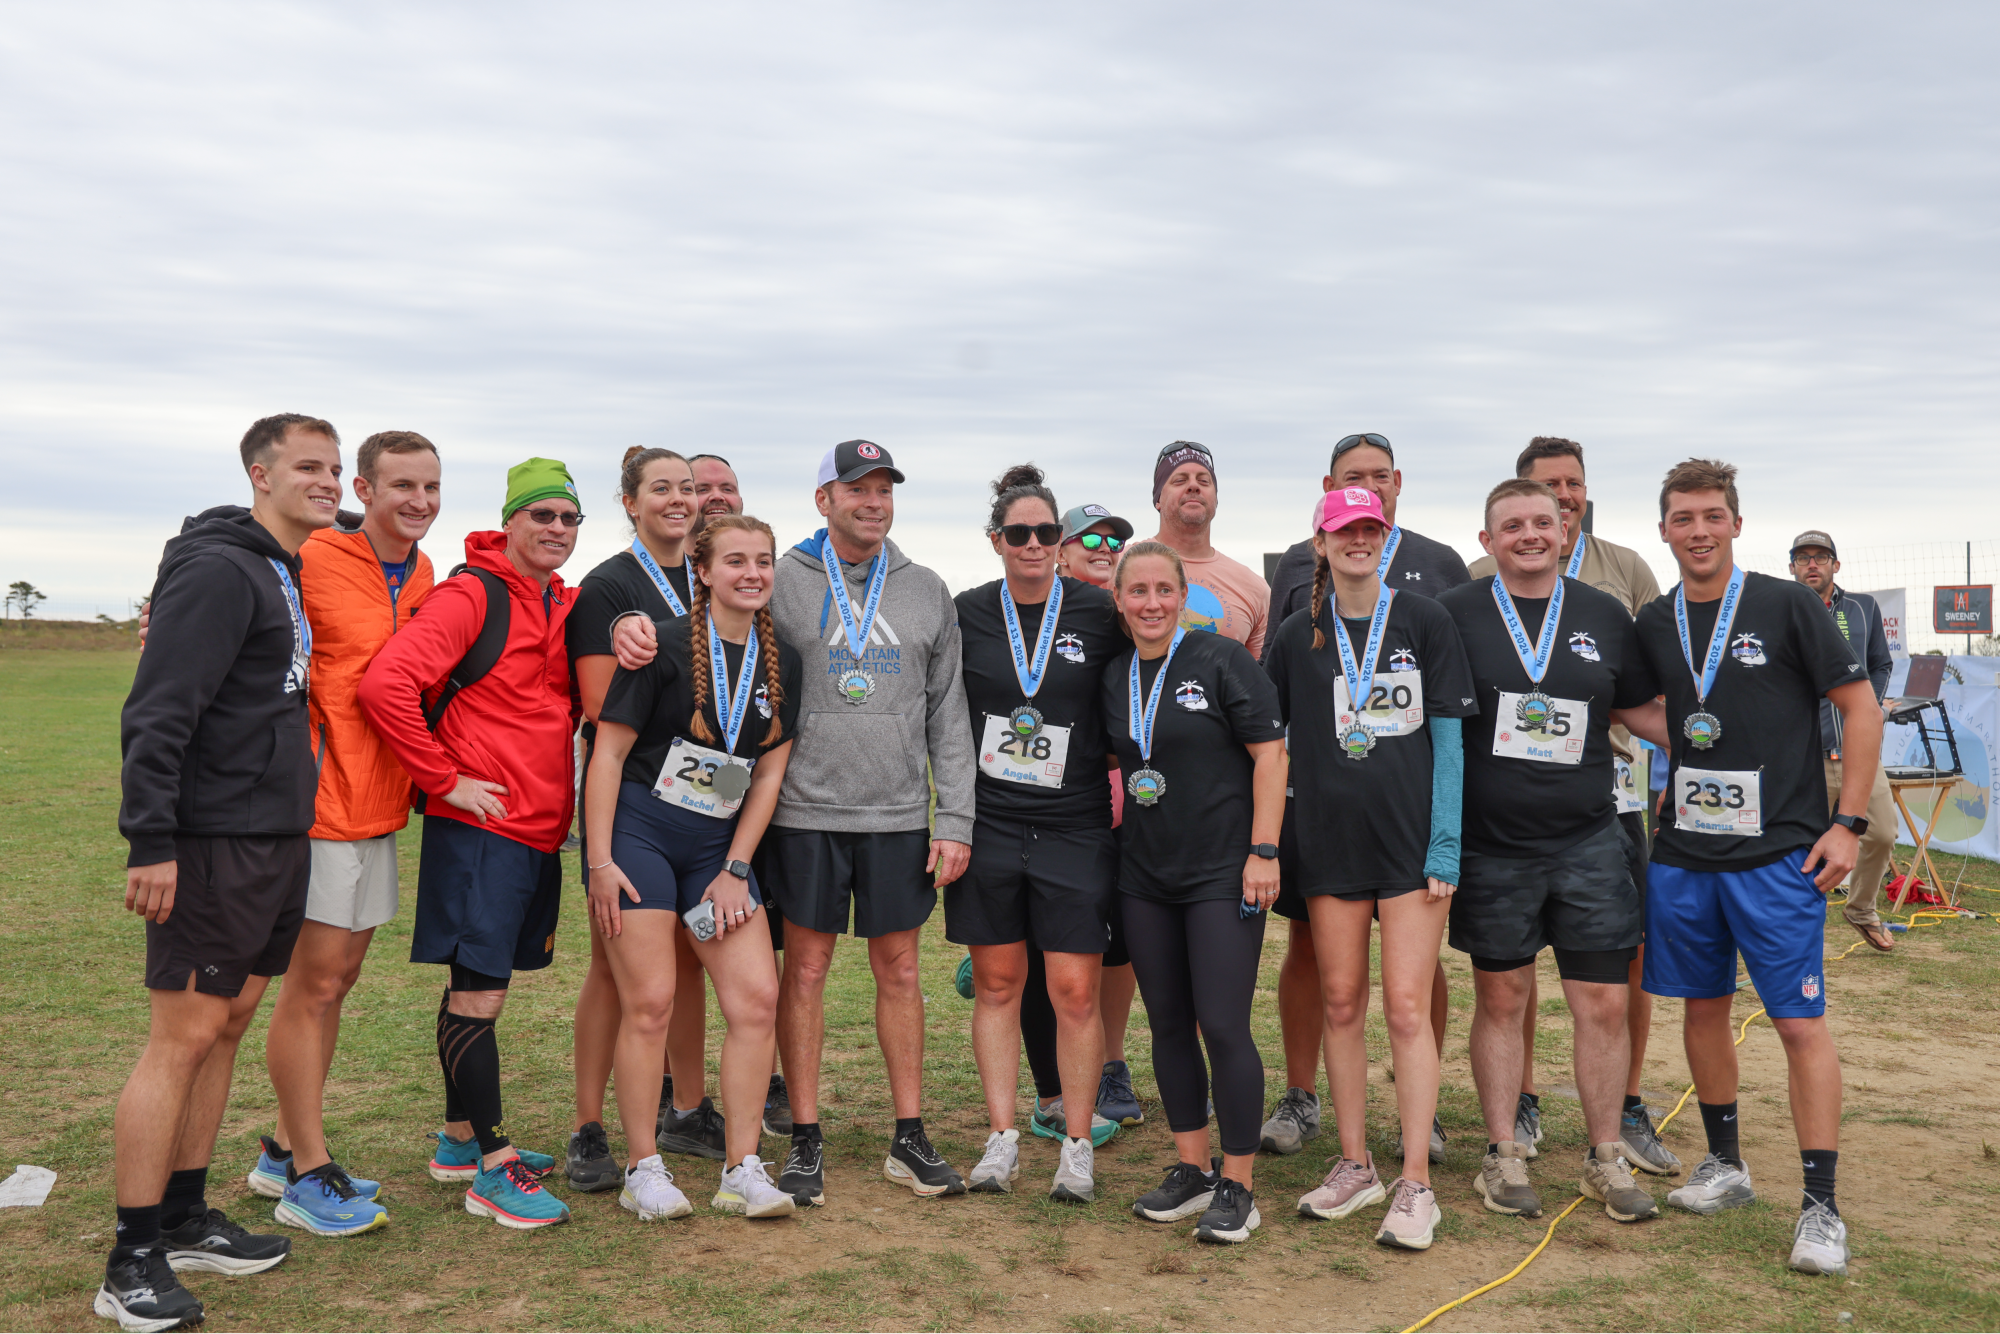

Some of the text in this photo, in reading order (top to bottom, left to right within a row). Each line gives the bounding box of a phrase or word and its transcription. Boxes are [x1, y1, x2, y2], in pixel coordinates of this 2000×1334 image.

[1570, 558, 1579, 575] Half
[639, 551, 684, 616] October 13, 20
[824, 547, 853, 627] October 13, 2024
[858, 595, 878, 643] Nantucket
[875, 576, 883, 595] Half
[1493, 579, 1529, 655] October 13, 2024
[1944, 612, 1981, 621] SWEENEY
[1002, 589, 1024, 667] October 13, 2024
[1031, 578, 1061, 682] Nantucket Half Maratho
[1679, 619, 1687, 639] Half
[1707, 582, 1739, 671] October 13, 2024
[1886, 629, 1898, 639] FM
[1362, 600, 1388, 682] October 13, 2024
[1536, 622, 1555, 668] Nantucket
[1889, 641, 1901, 651] dio
[828, 648, 900, 661] MONTAIN
[1340, 642, 1350, 657] 13,
[1345, 659, 1357, 684] 2024
[716, 659, 724, 680] Half
[827, 662, 901, 675] ATHETICS
[729, 683, 749, 736] Nantucket
[743, 661, 753, 682] Half
[1366, 723, 1398, 733] arrell
[997, 730, 1052, 760] 218
[1527, 746, 1553, 758] Matt
[1002, 768, 1038, 781] Angela
[680, 795, 715, 812] Rachel
[1685, 780, 1745, 809] 233
[1694, 820, 1734, 831] Seamus
[1803, 984, 1817, 996] NFL
